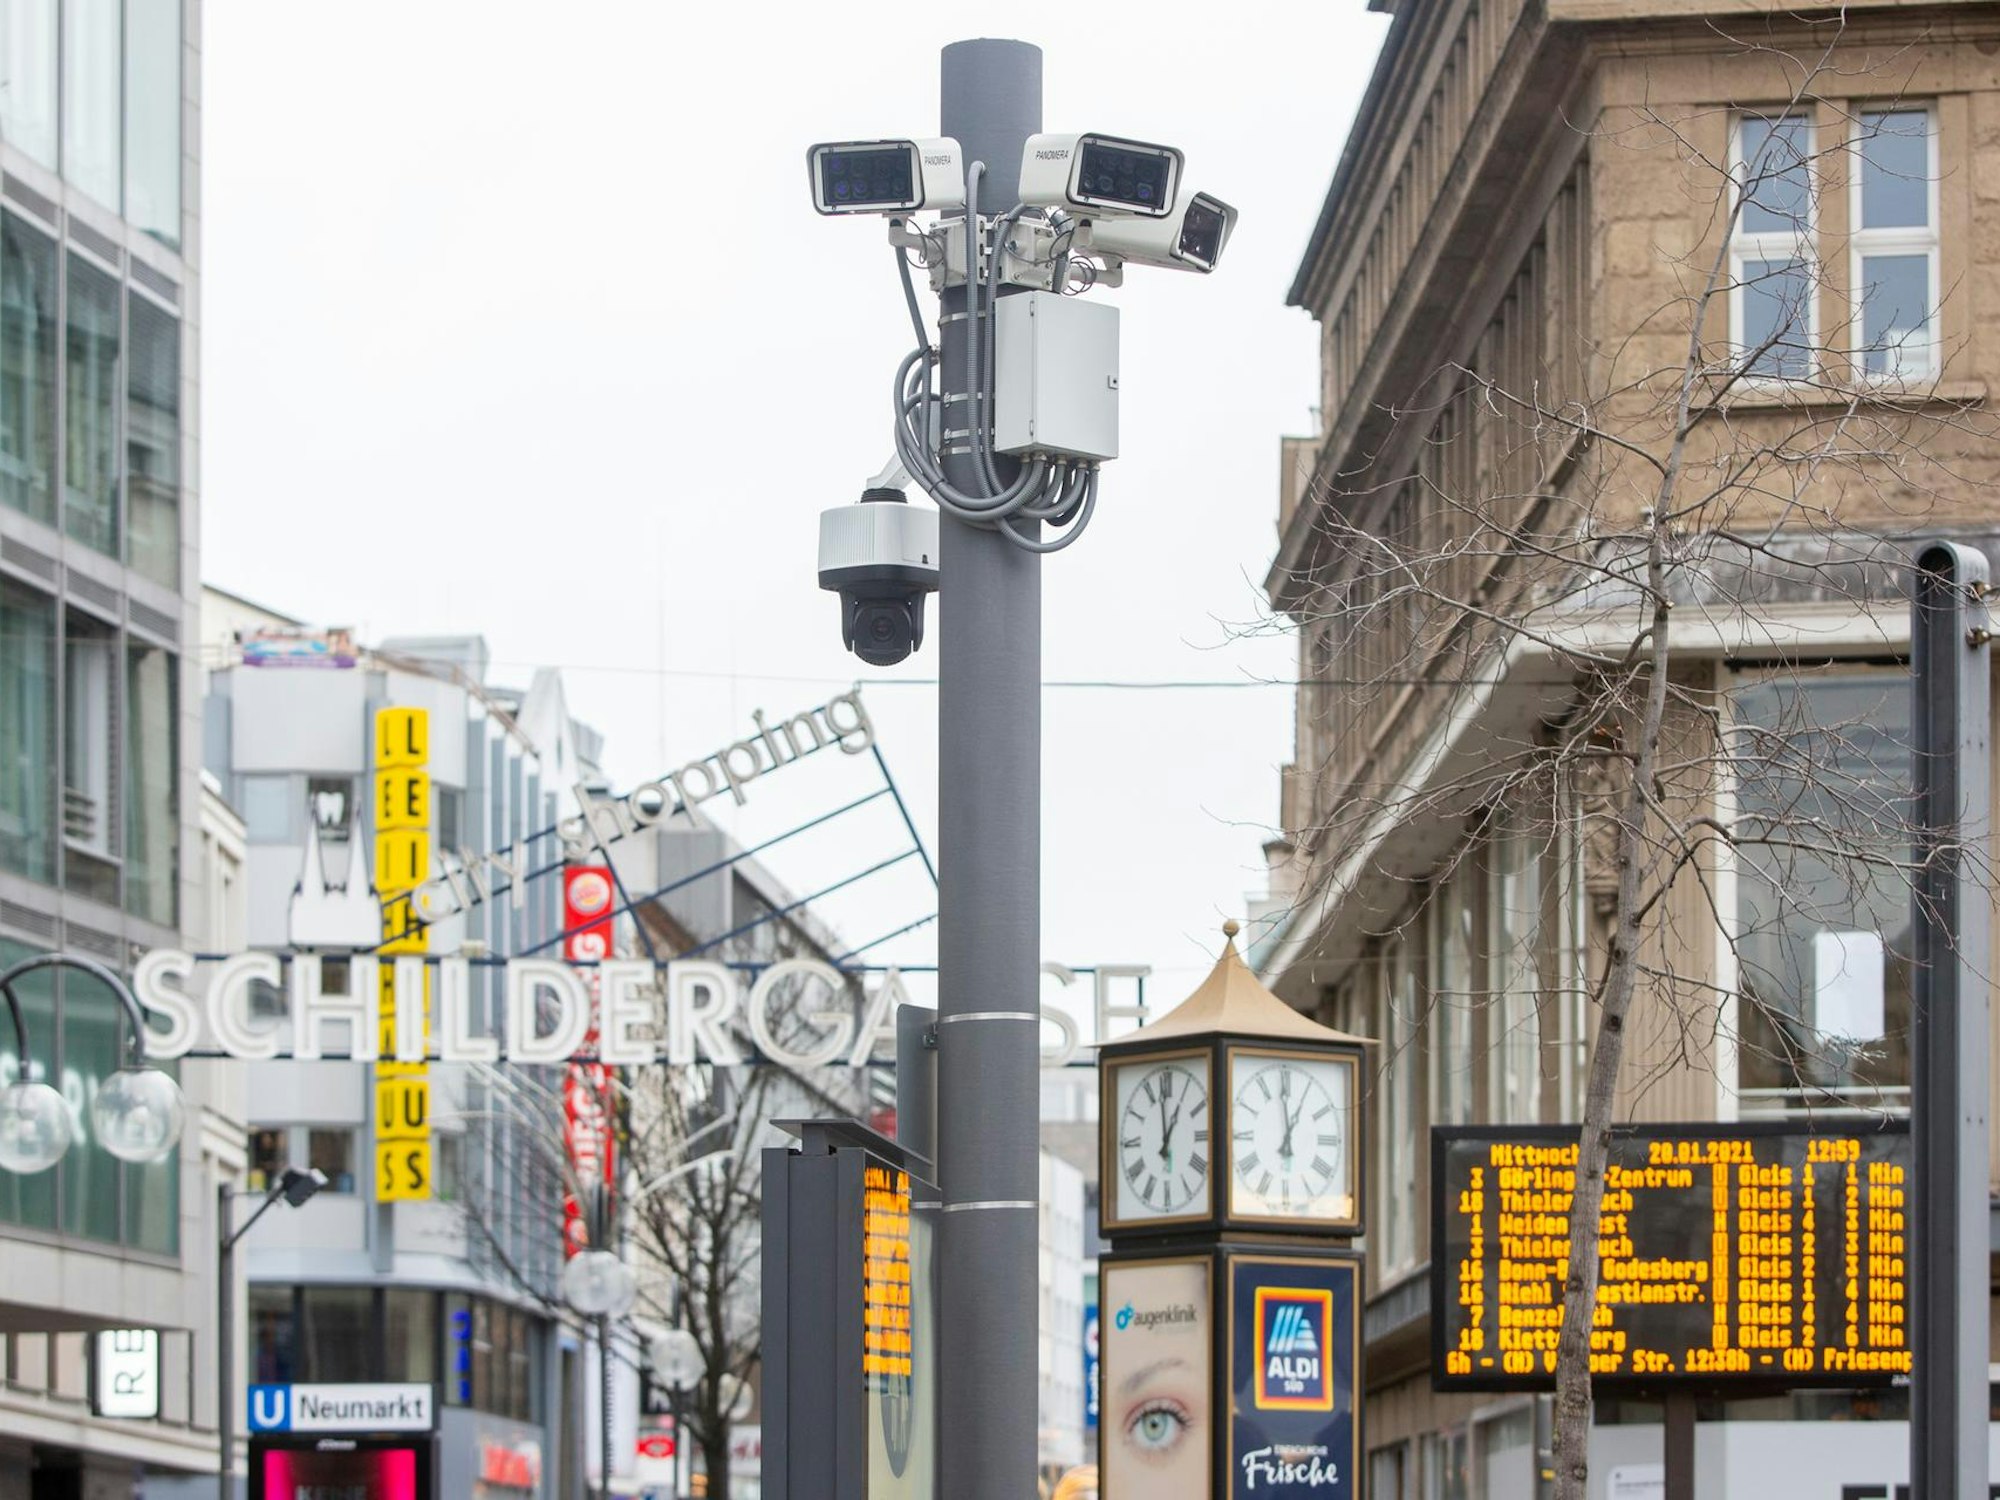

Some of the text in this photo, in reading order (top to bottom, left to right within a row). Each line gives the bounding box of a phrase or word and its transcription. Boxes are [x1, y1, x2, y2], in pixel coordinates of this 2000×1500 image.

[924, 154, 952, 166] PANOMERA
[1035, 150, 1069, 161] PANOMERA
[556, 690, 875, 858] shopping
[405, 715, 425, 1190] LEIHUS
[134, 948, 1153, 1069] SCHILDERGASE
[1649, 1142, 1754, 1162] 20.01.2021
[1806, 1140, 1860, 1161] 12:59
[1470, 1168, 1483, 1189] 3
[1738, 1164, 1792, 1186] Gleis
[1802, 1164, 1815, 1185] 1
[1846, 1163, 1858, 1184] 1
[1869, 1163, 1904, 1184] Min
[1459, 1191, 1484, 1212] 18
[1500, 1190, 1633, 1211] Thieleuch
[1738, 1188, 1792, 1209] Gleis
[1802, 1187, 1815, 1208] 1
[1846, 1186, 1859, 1207] 2
[1868, 1186, 1904, 1207] Min
[1470, 1214, 1483, 1235] 1
[1499, 1214, 1568, 1234] Weiden
[1598, 1212, 1627, 1234] st
[1738, 1211, 1792, 1232] Gleis
[1802, 1210, 1815, 1230] 4
[1846, 1209, 1859, 1231] 3
[1869, 1209, 1904, 1230] Min
[1470, 1237, 1483, 1258] 3
[1499, 1236, 1633, 1257] Thieleuch
[1738, 1234, 1792, 1255] Gleis
[1802, 1233, 1815, 1254] 2
[1846, 1232, 1859, 1254] 3
[1869, 1232, 1904, 1253] Min
[1459, 1260, 1484, 1281] 16
[1499, 1259, 1569, 1281] Bonn-B
[1602, 1257, 1708, 1282] Godesberg
[1738, 1257, 1792, 1278] Gleis
[1802, 1256, 1815, 1277] 2
[1846, 1255, 1859, 1277] 3
[1869, 1255, 1904, 1276] Min
[1459, 1283, 1484, 1304] 16
[1499, 1282, 1552, 1304] Niehl
[1562, 1281, 1706, 1303] astianstr.
[1738, 1280, 1792, 1301] Gleis
[1802, 1279, 1815, 1300] 1
[1845, 1279, 1859, 1300] 4
[1869, 1278, 1904, 1299] Min
[1133, 1303, 1197, 1331] augenklinik
[1470, 1305, 1484, 1327] 7
[1738, 1303, 1792, 1324] Gleis
[1802, 1302, 1815, 1323] 4
[1845, 1302, 1858, 1323] 4
[1869, 1302, 1904, 1323] Min
[1459, 1328, 1484, 1350] 18
[1499, 1327, 1626, 1352] Kletterg
[1738, 1326, 1792, 1347] Gleis
[1802, 1325, 1815, 1346] 2
[1845, 1325, 1859, 1346] 6
[1869, 1325, 1904, 1346] Min
[1267, 1356, 1320, 1380] ALDI
[1632, 1350, 1675, 1371] Str.
[253, 1389, 423, 1428] U Neumarkt
[1242, 1446, 1340, 1490] Frische
